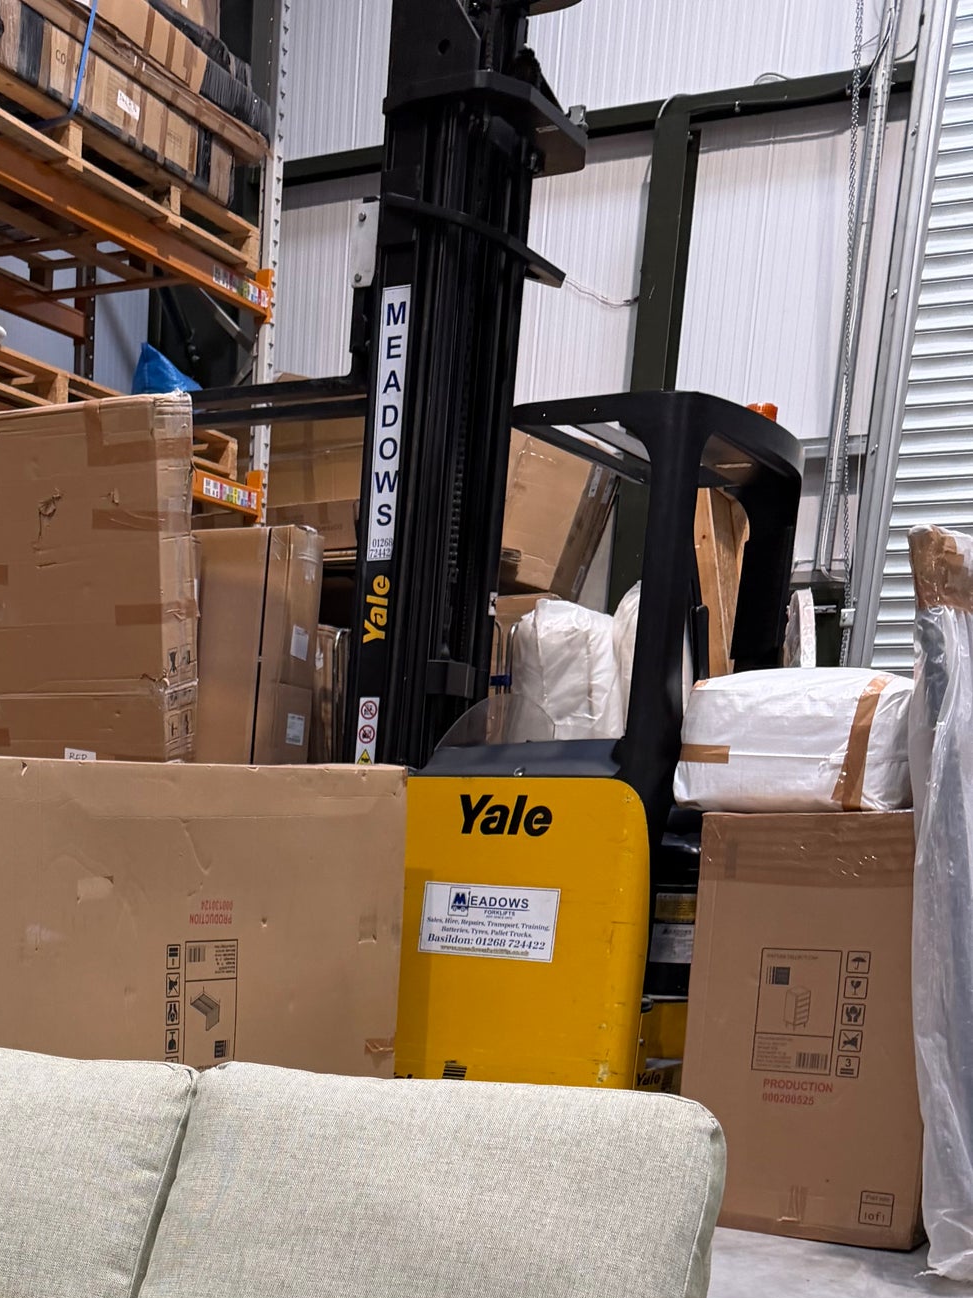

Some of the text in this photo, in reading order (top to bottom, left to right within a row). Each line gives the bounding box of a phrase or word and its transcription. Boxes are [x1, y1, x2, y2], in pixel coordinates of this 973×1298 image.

[374, 301, 407, 527] MEADOWS
[372, 538, 393, 548] 01268
[363, 574, 391, 644] Yale
[460, 794, 553, 837] Yale
[453, 892, 529, 909] MEADOWS
[189, 914, 232, 925] PRODUCTION
[487, 921, 519, 929] Transport,
[428, 933, 545, 950] Basildon: 01268 724422
[845, 1058, 851, 1067] 3
[637, 1072, 660, 1086] Yale
[763, 1078, 833, 1093] PRODUCTION
